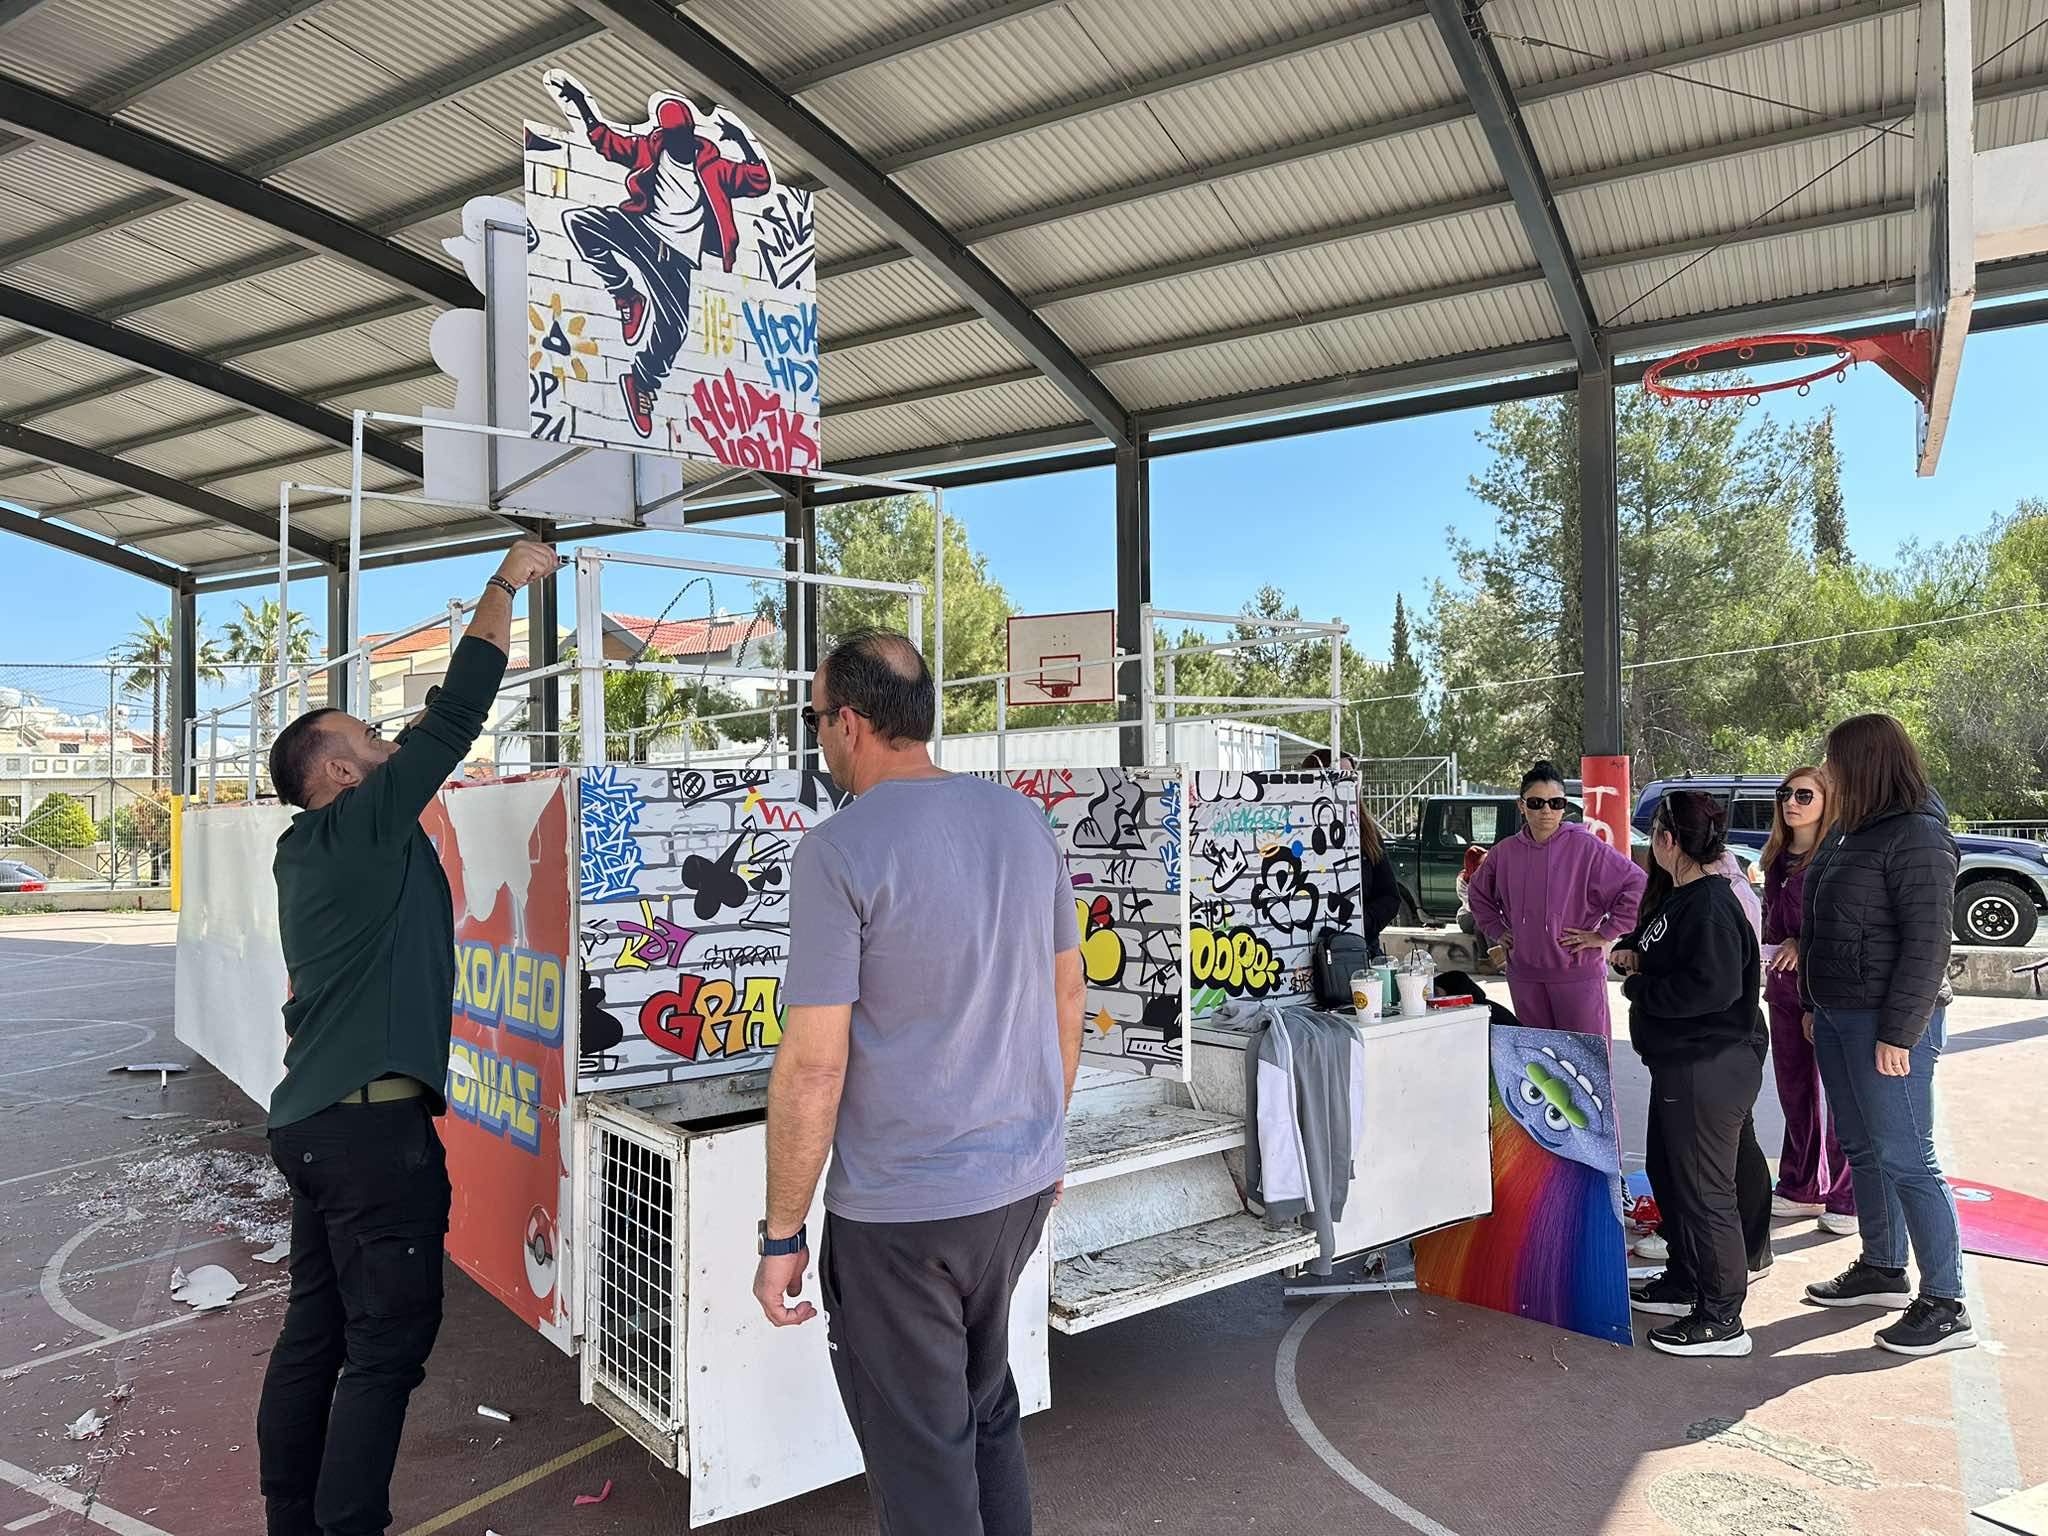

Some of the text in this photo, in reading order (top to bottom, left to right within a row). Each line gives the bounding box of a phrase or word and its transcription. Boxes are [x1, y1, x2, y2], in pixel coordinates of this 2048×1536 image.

[453, 943, 563, 1032] ΧΟΛΕΙΟ
[638, 973, 788, 1062] GRA
[449, 1041, 538, 1138] ΟΝΙΑΣ
